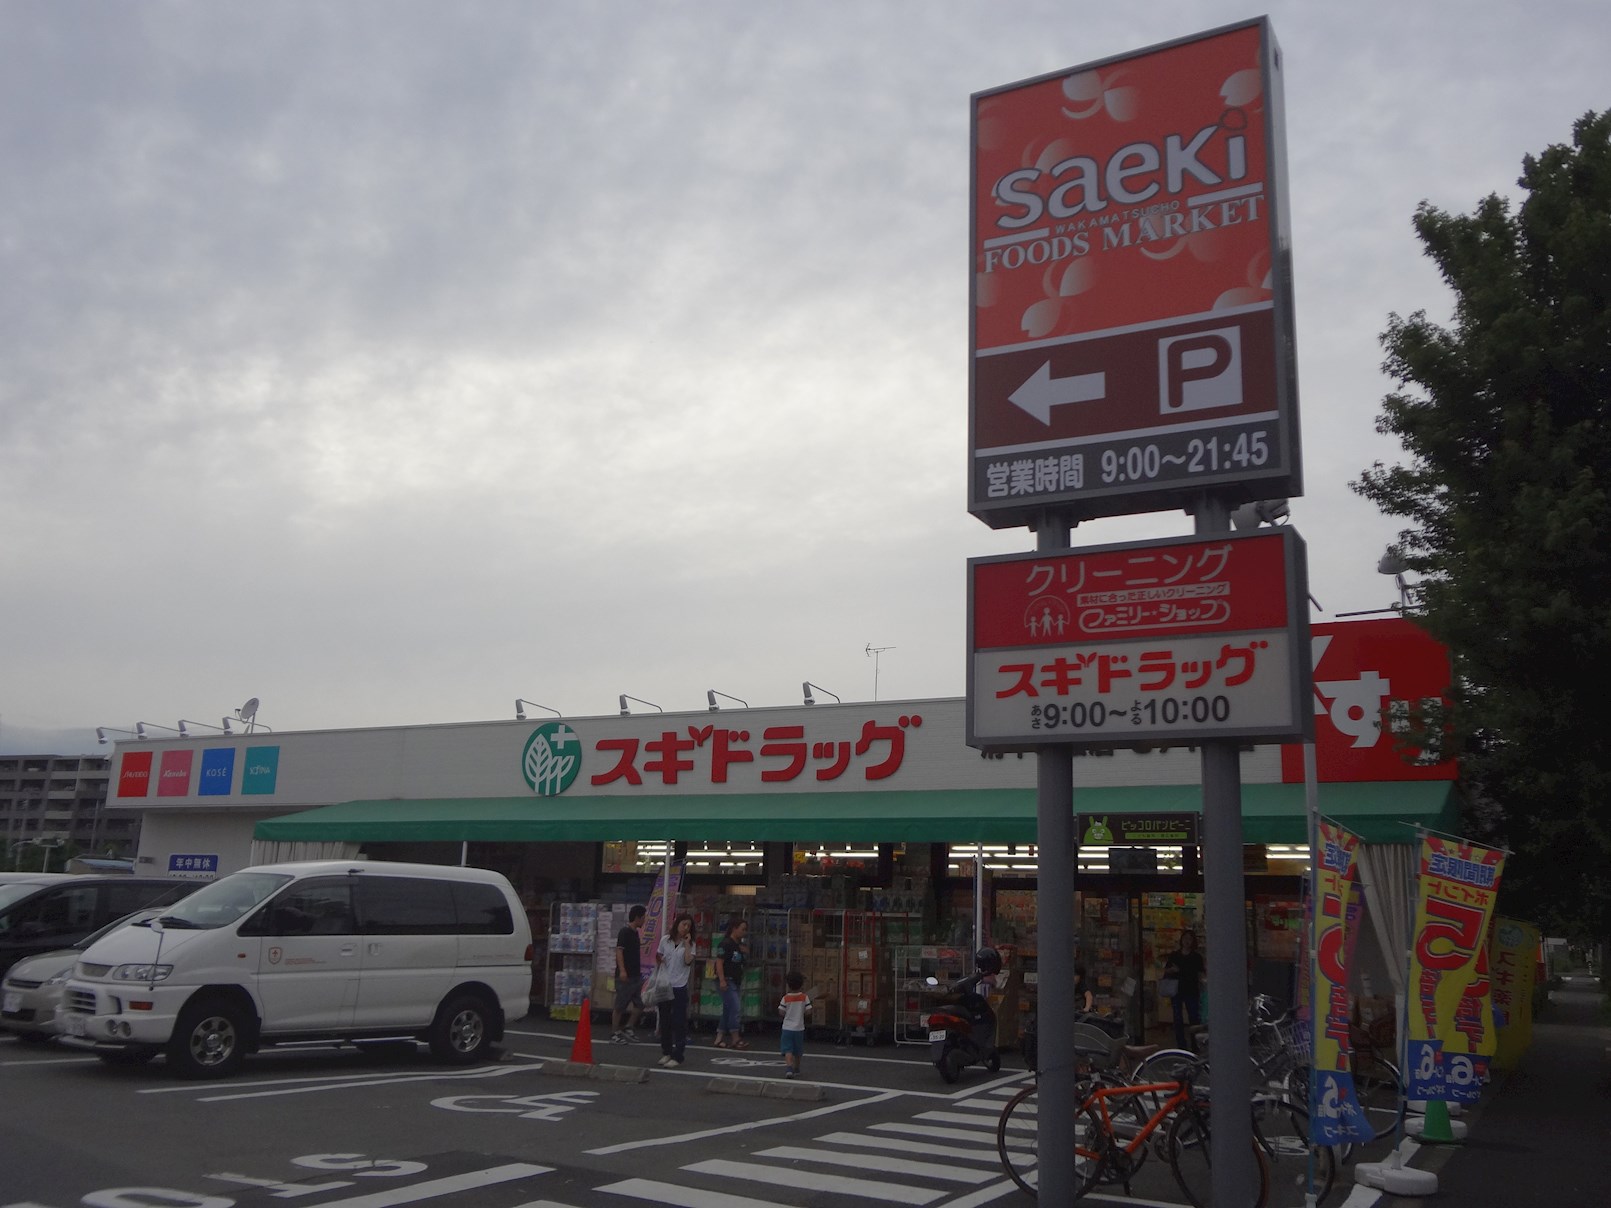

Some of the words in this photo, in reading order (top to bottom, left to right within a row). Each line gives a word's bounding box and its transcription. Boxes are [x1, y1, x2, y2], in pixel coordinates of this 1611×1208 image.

[983, 232, 1090, 274] FOODS
[1102, 194, 1264, 250] MARKET
[1055, 200, 1180, 234] WAKAMATSUCHO
[1167, 334, 1233, 409] P
[986, 454, 1084, 498] 営業時間
[1025, 544, 1234, 596] クリーニング
[995, 640, 1269, 699] スギドラッグ
[206, 767, 227, 776] KOSÉ
[590, 714, 923, 786] スギドラッグ
[175, 857, 211, 868] 年中無休
